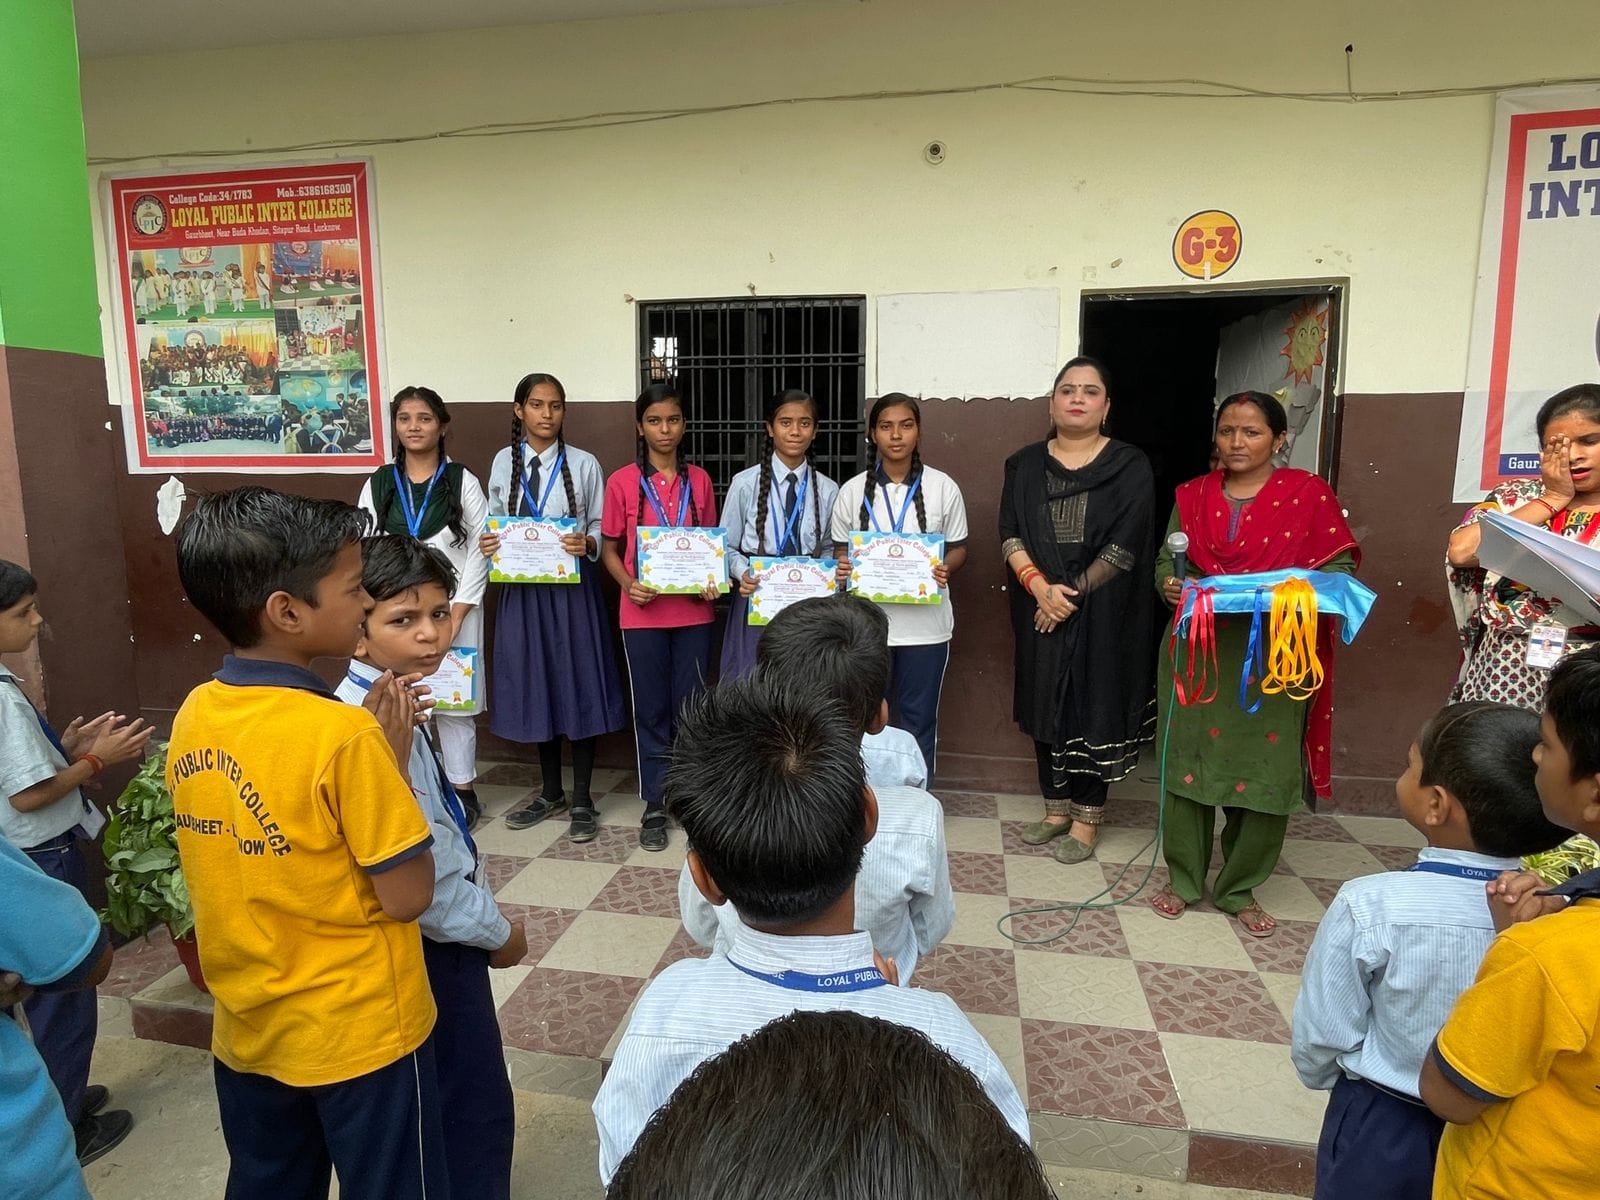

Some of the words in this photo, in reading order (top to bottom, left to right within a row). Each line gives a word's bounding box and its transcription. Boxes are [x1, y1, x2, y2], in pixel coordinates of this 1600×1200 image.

[168, 194, 197, 206] College
[170, 206, 209, 228] LOYAL
[211, 203, 255, 225] PUBLIC
[256, 201, 296, 222] INTER
[299, 198, 352, 220] COLLEGE
[217, 228, 231, 238] Near
[273, 225, 294, 236] Sitapur
[296, 223, 313, 234] Road,
[1181, 226, 1237, 265] G-3
[1508, 457, 1541, 469] Gaur
[173, 748, 213, 785] PUBLIC
[217, 748, 243, 789] INTER
[239, 781, 292, 857] COLLEGE
[1461, 868, 1488, 878] LOYAL
[817, 975, 852, 987] LOYAL
